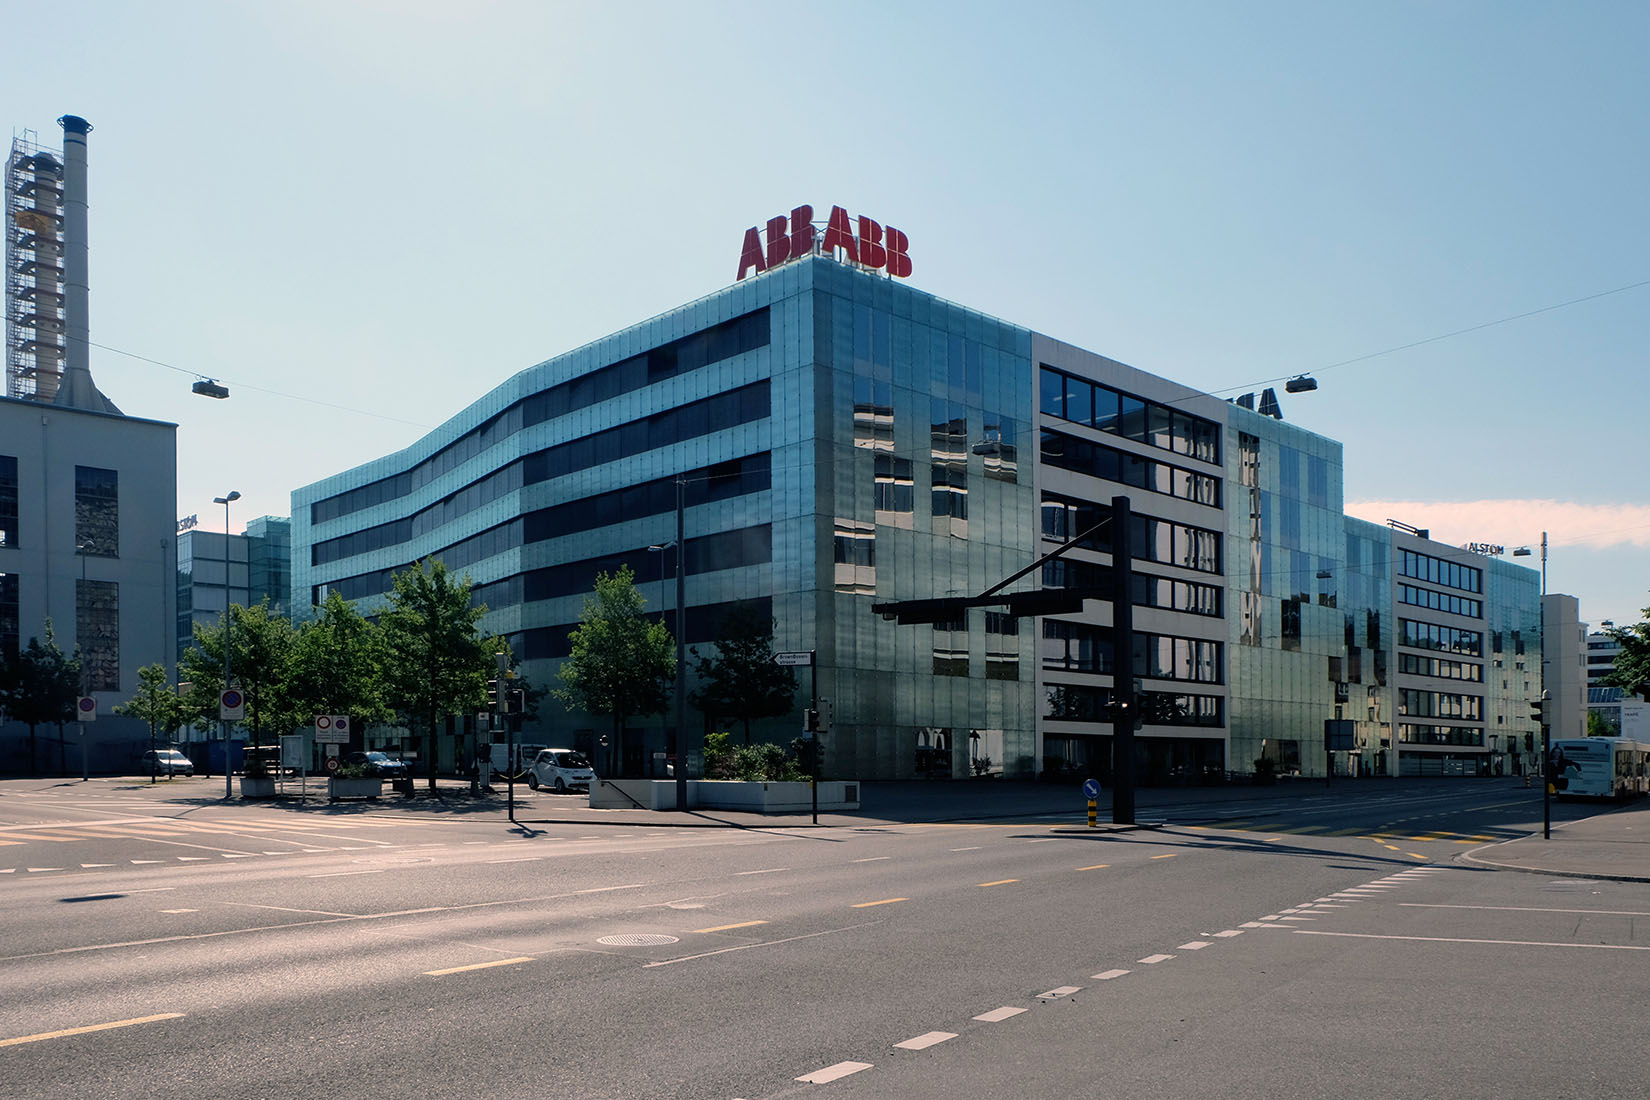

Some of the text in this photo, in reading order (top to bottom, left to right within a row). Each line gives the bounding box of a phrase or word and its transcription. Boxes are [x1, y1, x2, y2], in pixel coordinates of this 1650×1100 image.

[737, 204, 815, 281] ABB
[821, 205, 912, 278] ABB
[1468, 542, 1504, 555] ALSTOM
